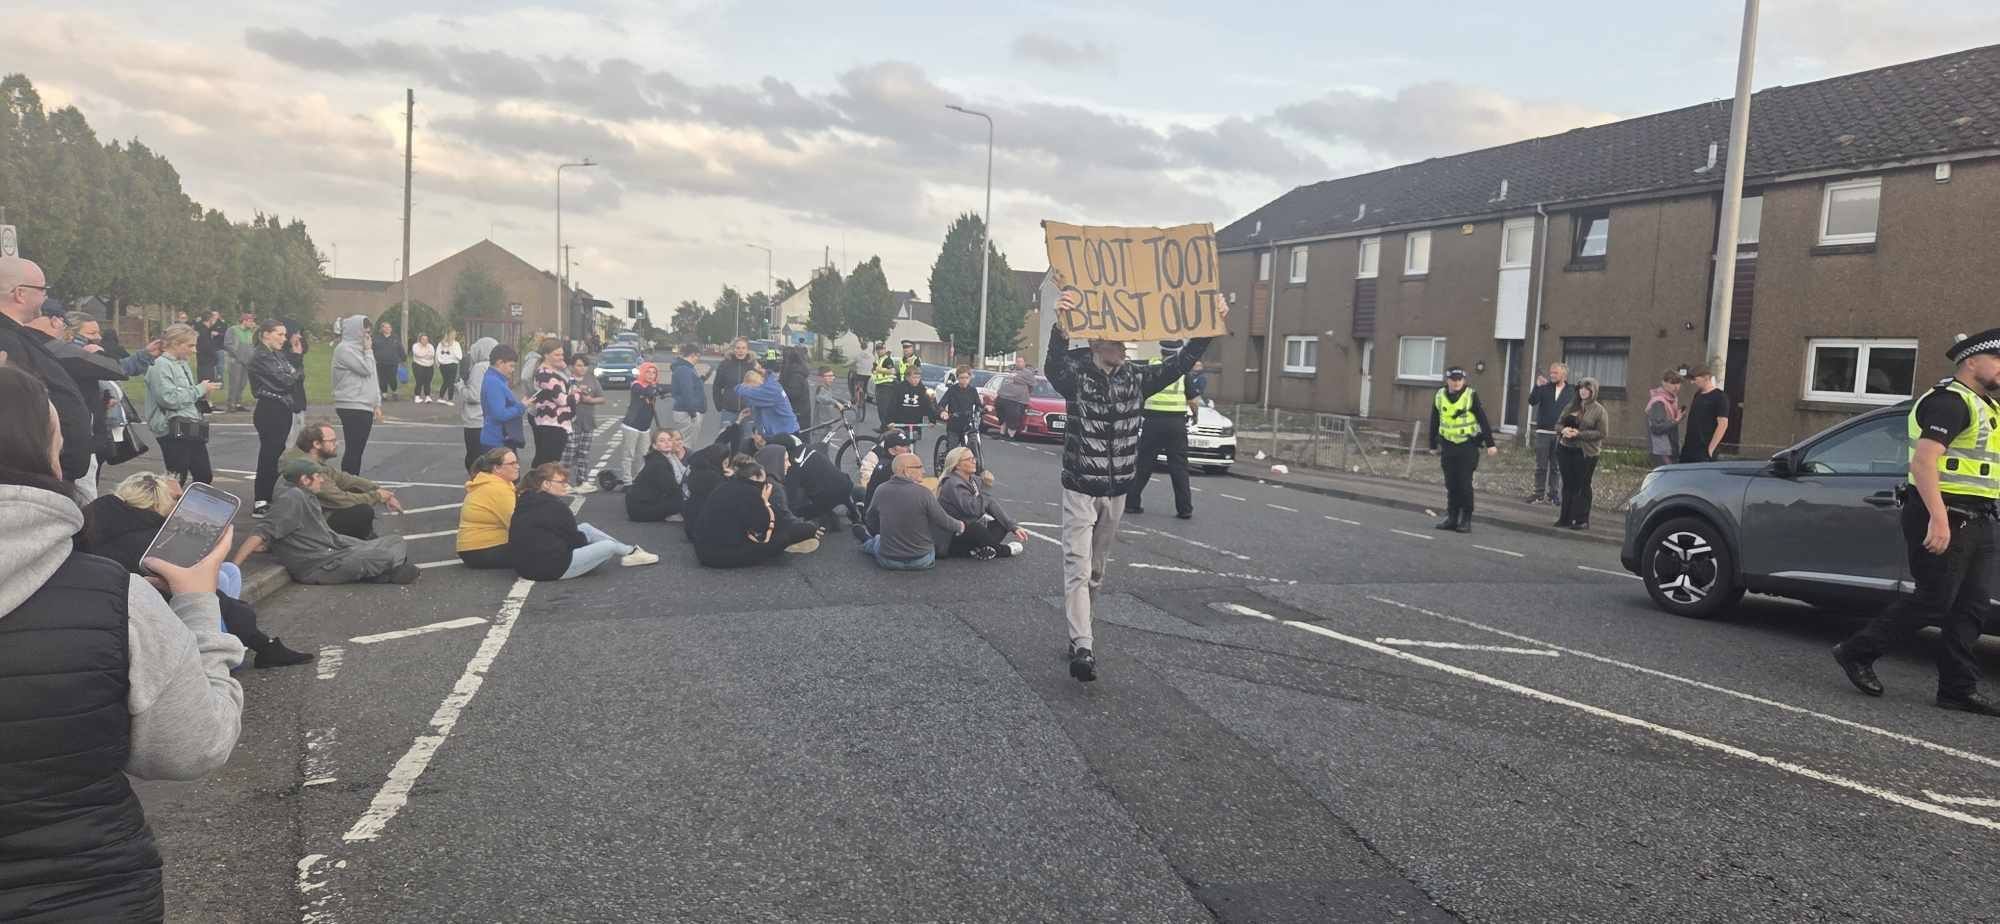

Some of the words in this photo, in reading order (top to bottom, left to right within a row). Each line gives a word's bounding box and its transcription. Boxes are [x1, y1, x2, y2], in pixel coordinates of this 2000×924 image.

[1055, 235, 1133, 287] TOOT
[1143, 235, 1217, 292] TOOT
[1061, 285, 1151, 332] BEAST
[1160, 289, 1218, 333] OUT
